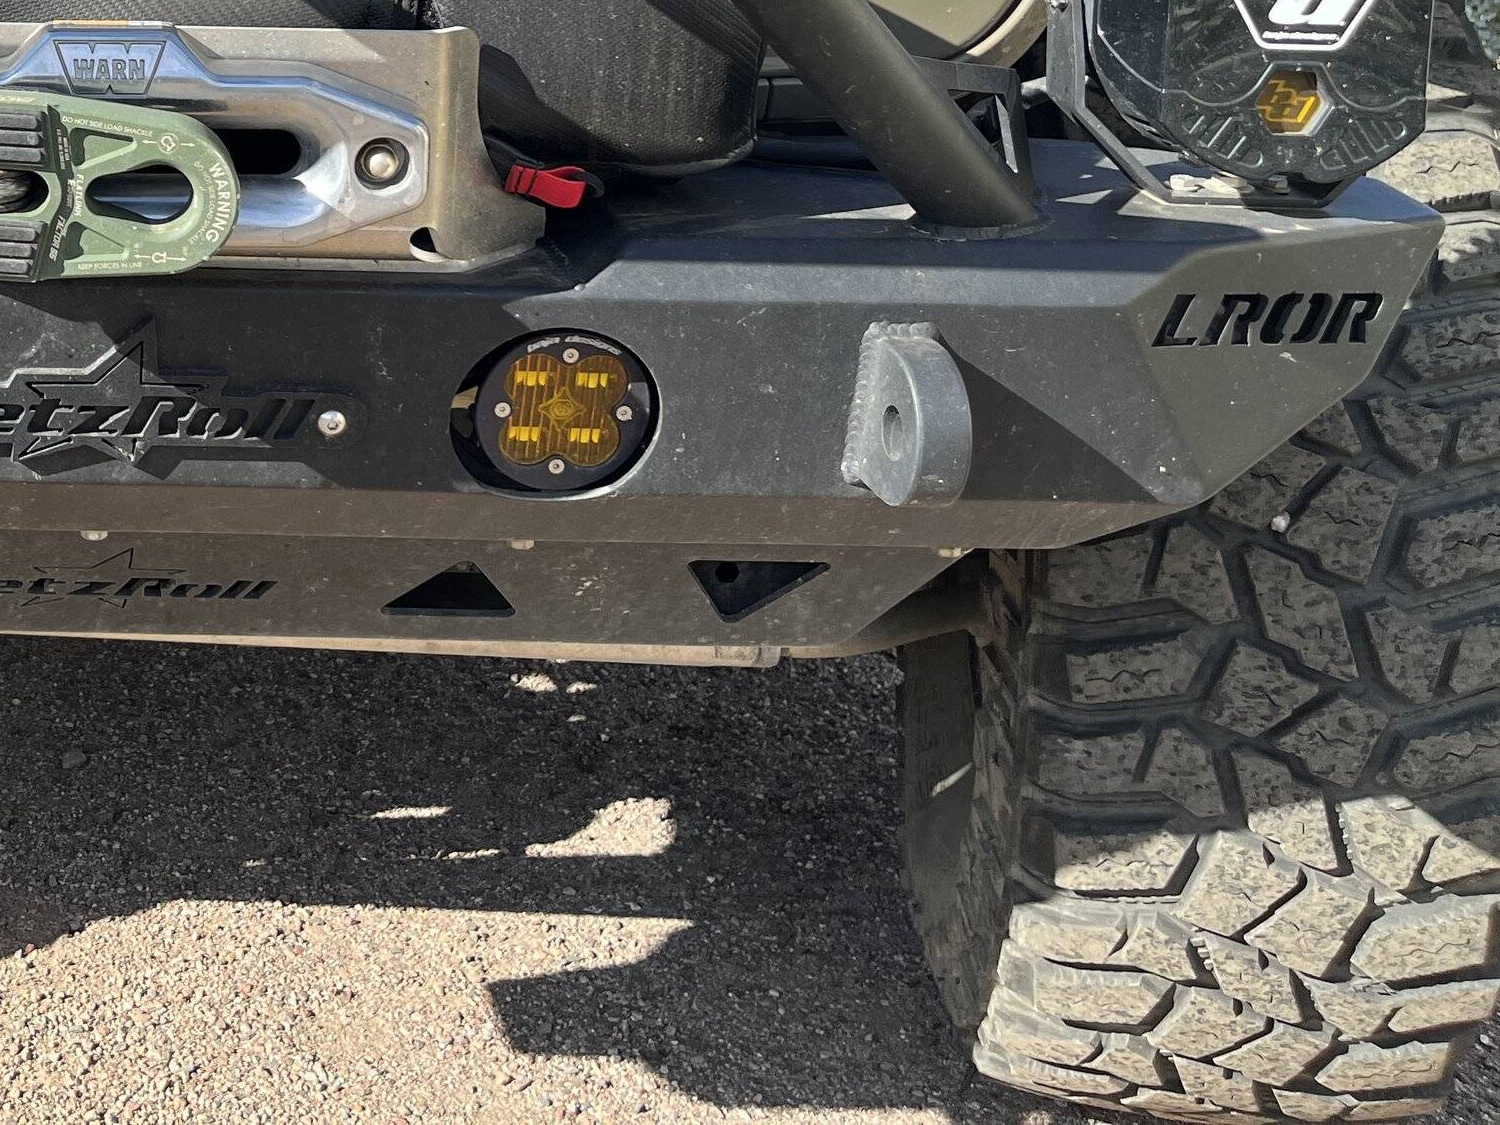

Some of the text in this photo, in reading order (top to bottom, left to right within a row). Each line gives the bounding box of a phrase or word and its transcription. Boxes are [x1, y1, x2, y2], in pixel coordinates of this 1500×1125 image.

[73, 58, 145, 80] WARN
[104, 123, 123, 132] LOAD
[73, 173, 84, 217] FLATLINK
[205, 162, 231, 243] WARNING
[51, 215, 66, 249] FACTOR
[77, 262, 94, 270] KEEP
[1151, 291, 1384, 347] LROR
